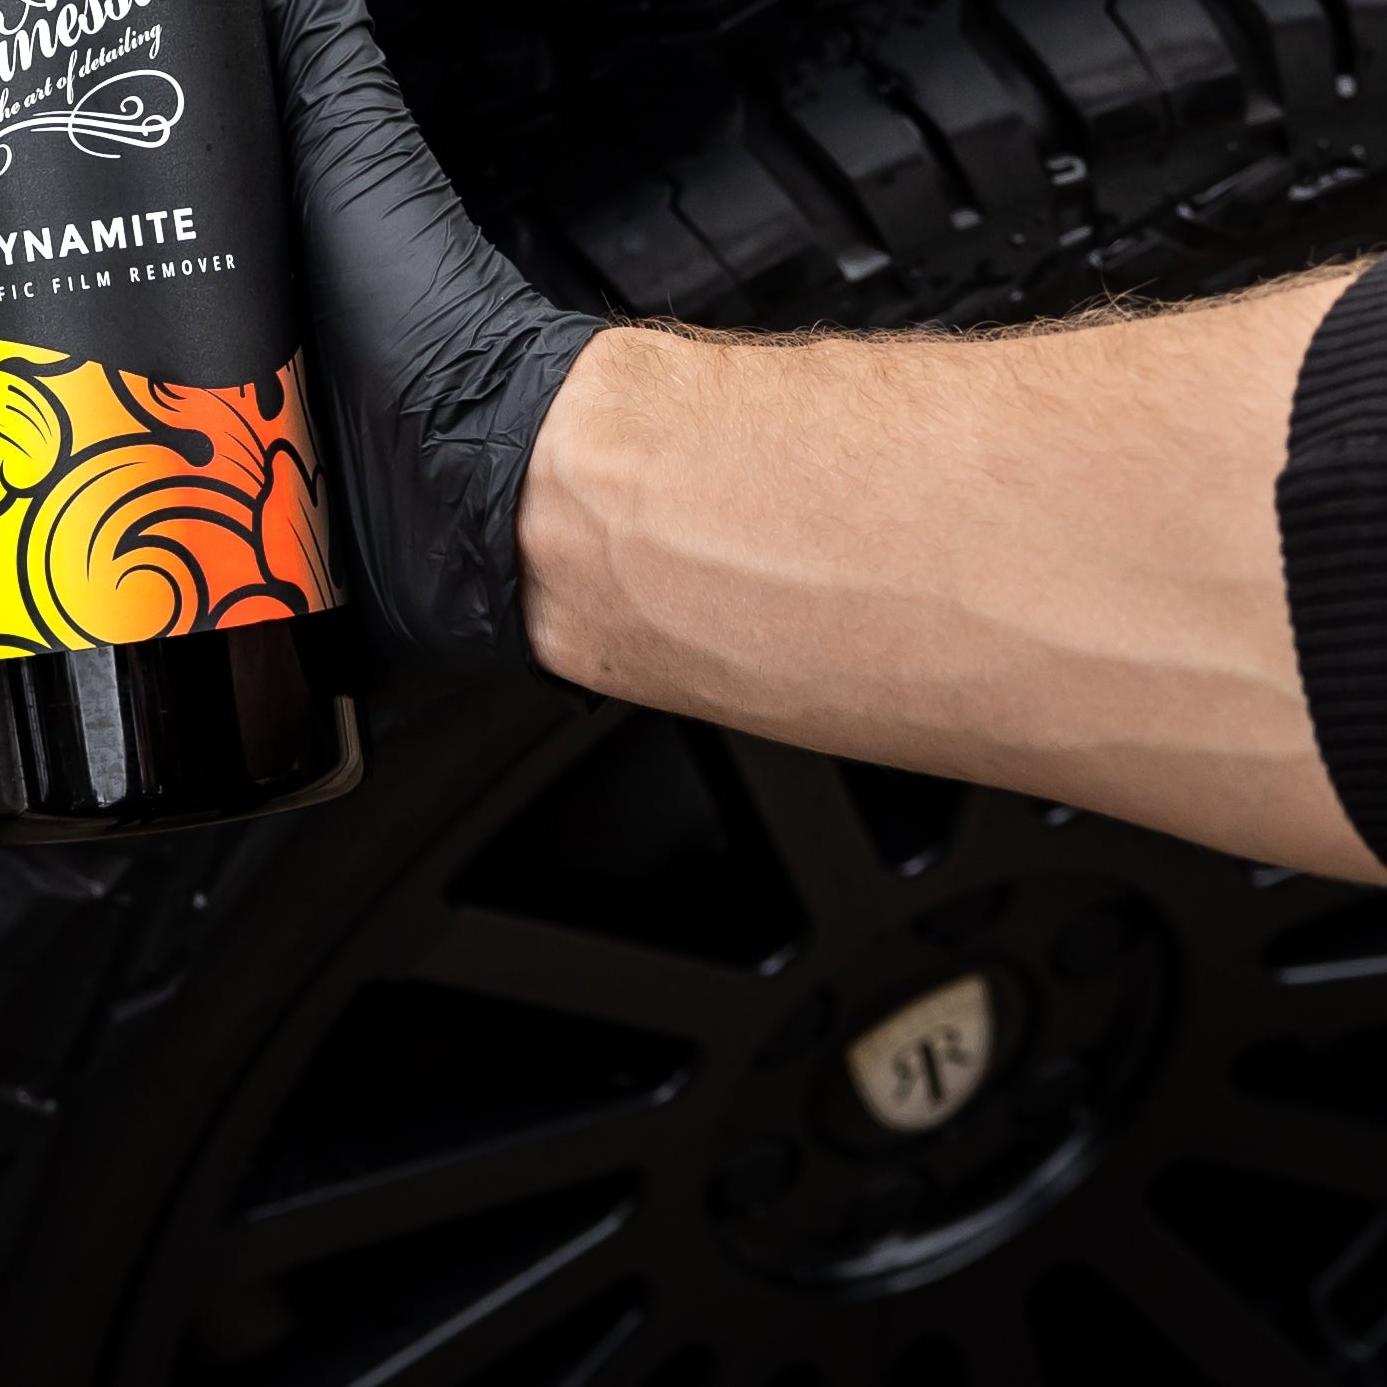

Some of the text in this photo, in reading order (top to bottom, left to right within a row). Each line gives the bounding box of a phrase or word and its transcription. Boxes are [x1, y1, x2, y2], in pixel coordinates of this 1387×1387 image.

[24, 77, 54, 109] art
[56, 50, 80, 105] of
[78, 22, 162, 60] detailing
[51, 270, 112, 294] FILM
[129, 253, 236, 283] REMOVER
